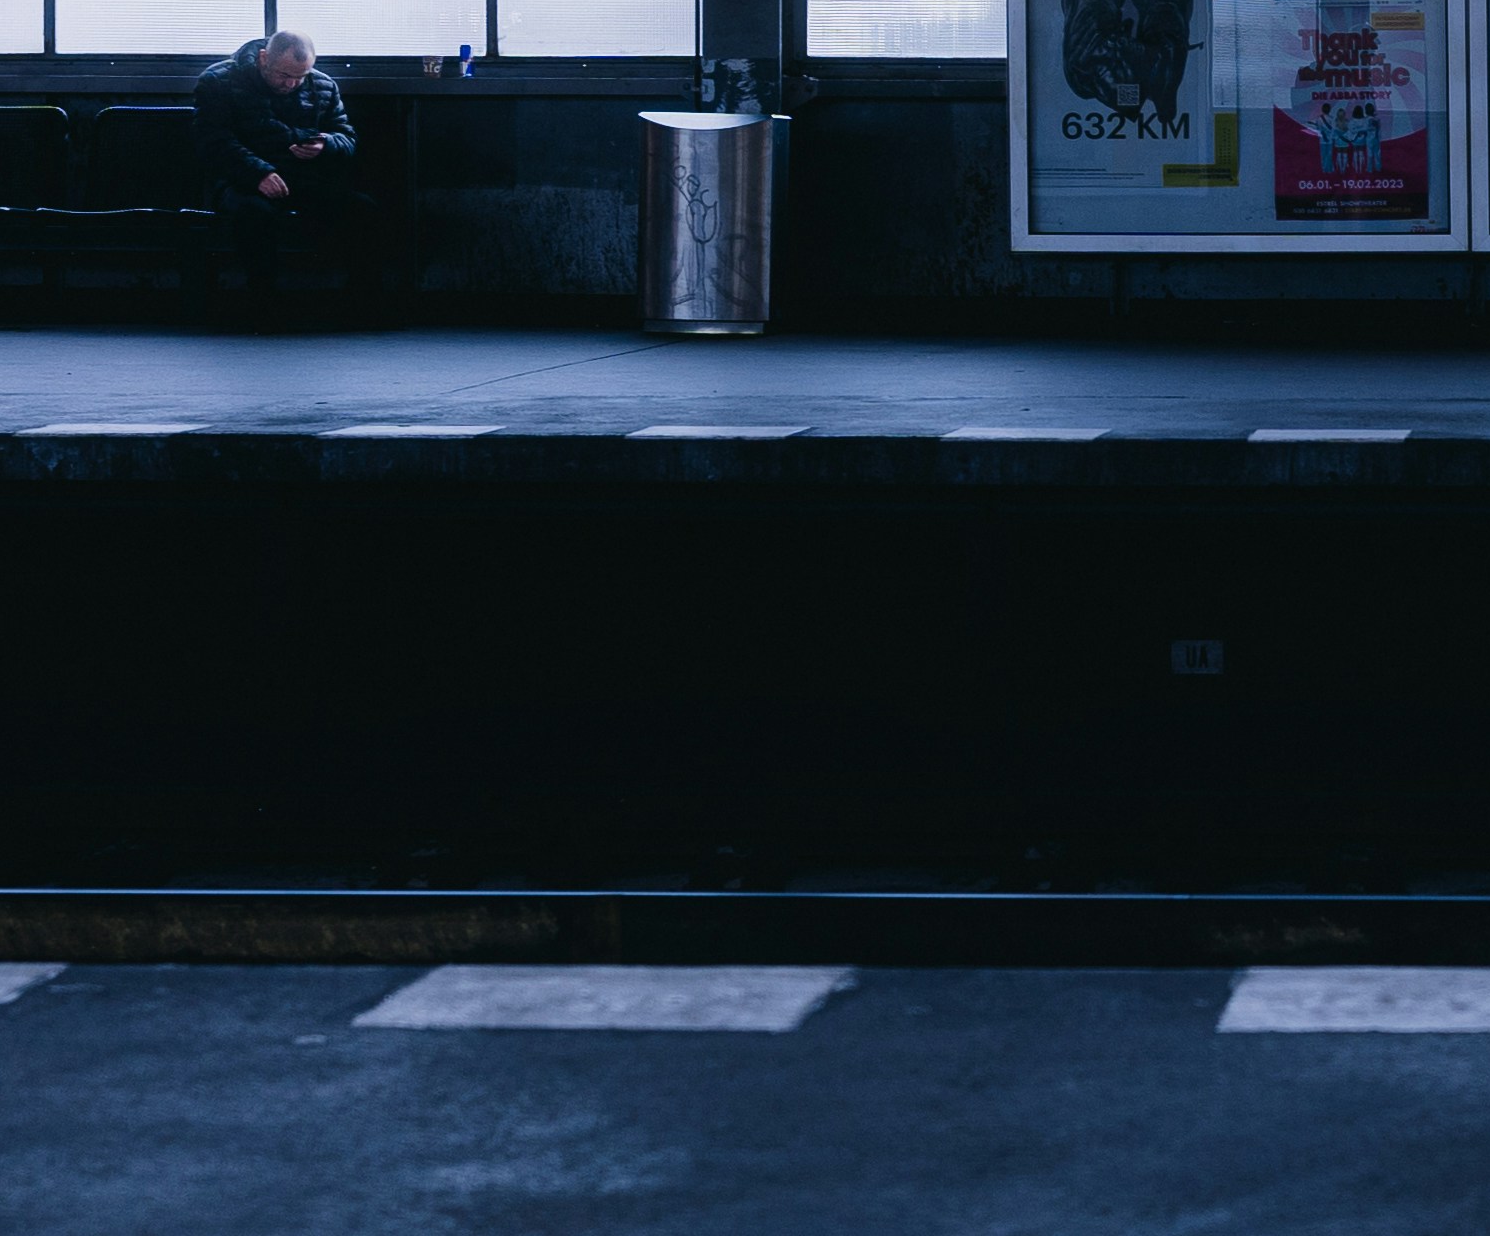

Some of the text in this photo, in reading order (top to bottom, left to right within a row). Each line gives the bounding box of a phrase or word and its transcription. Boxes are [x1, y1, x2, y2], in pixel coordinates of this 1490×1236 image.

[1298, 28, 1379, 51] Thank
[1325, 63, 1410, 88] music
[1311, 90, 1393, 101] DIE ABBA STORY
[1062, 112, 1190, 139] 632 KM
[1342, 178, 1405, 190] 19.02.2023
